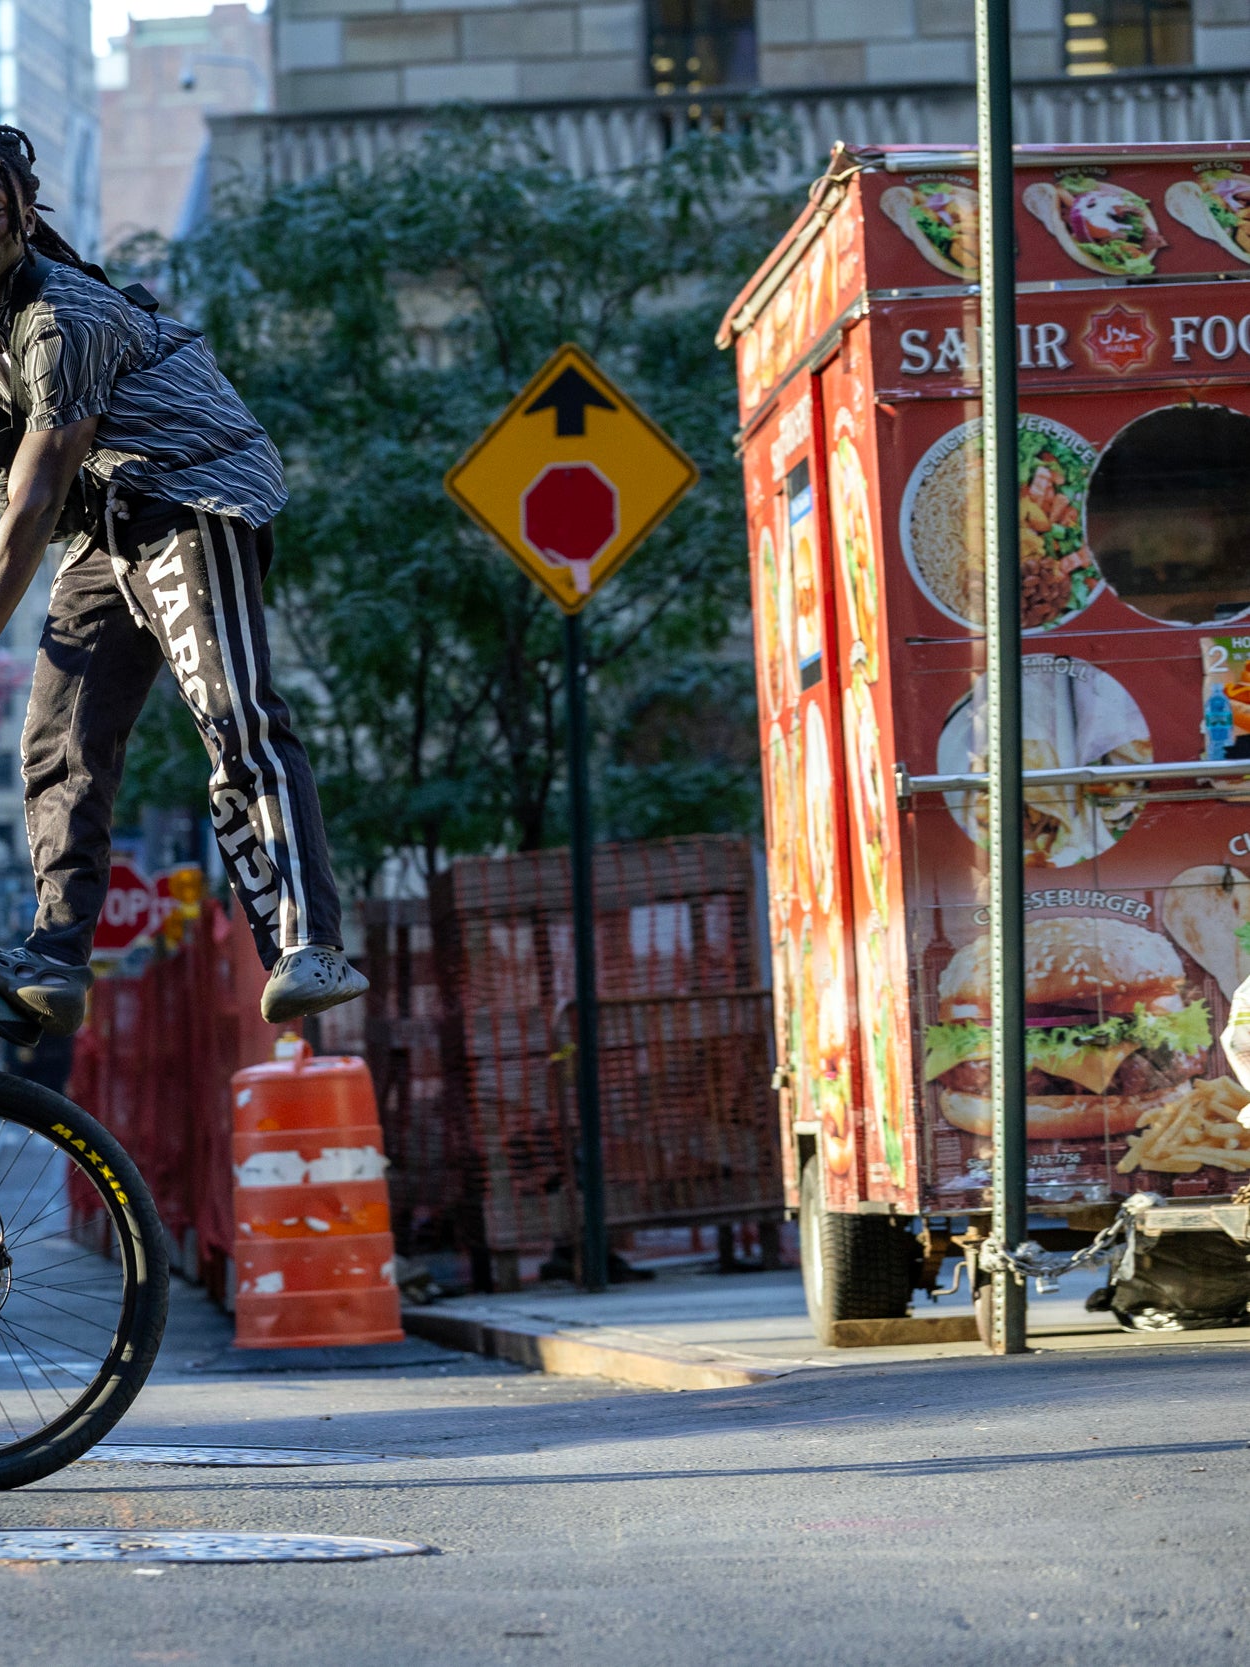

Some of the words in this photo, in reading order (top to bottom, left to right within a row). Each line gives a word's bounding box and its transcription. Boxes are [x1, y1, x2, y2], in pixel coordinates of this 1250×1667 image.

[900, 323, 1073, 375] SAIR
[921, 419, 985, 477] CHICKE
[51, 1123, 129, 1205] MAXXIS
